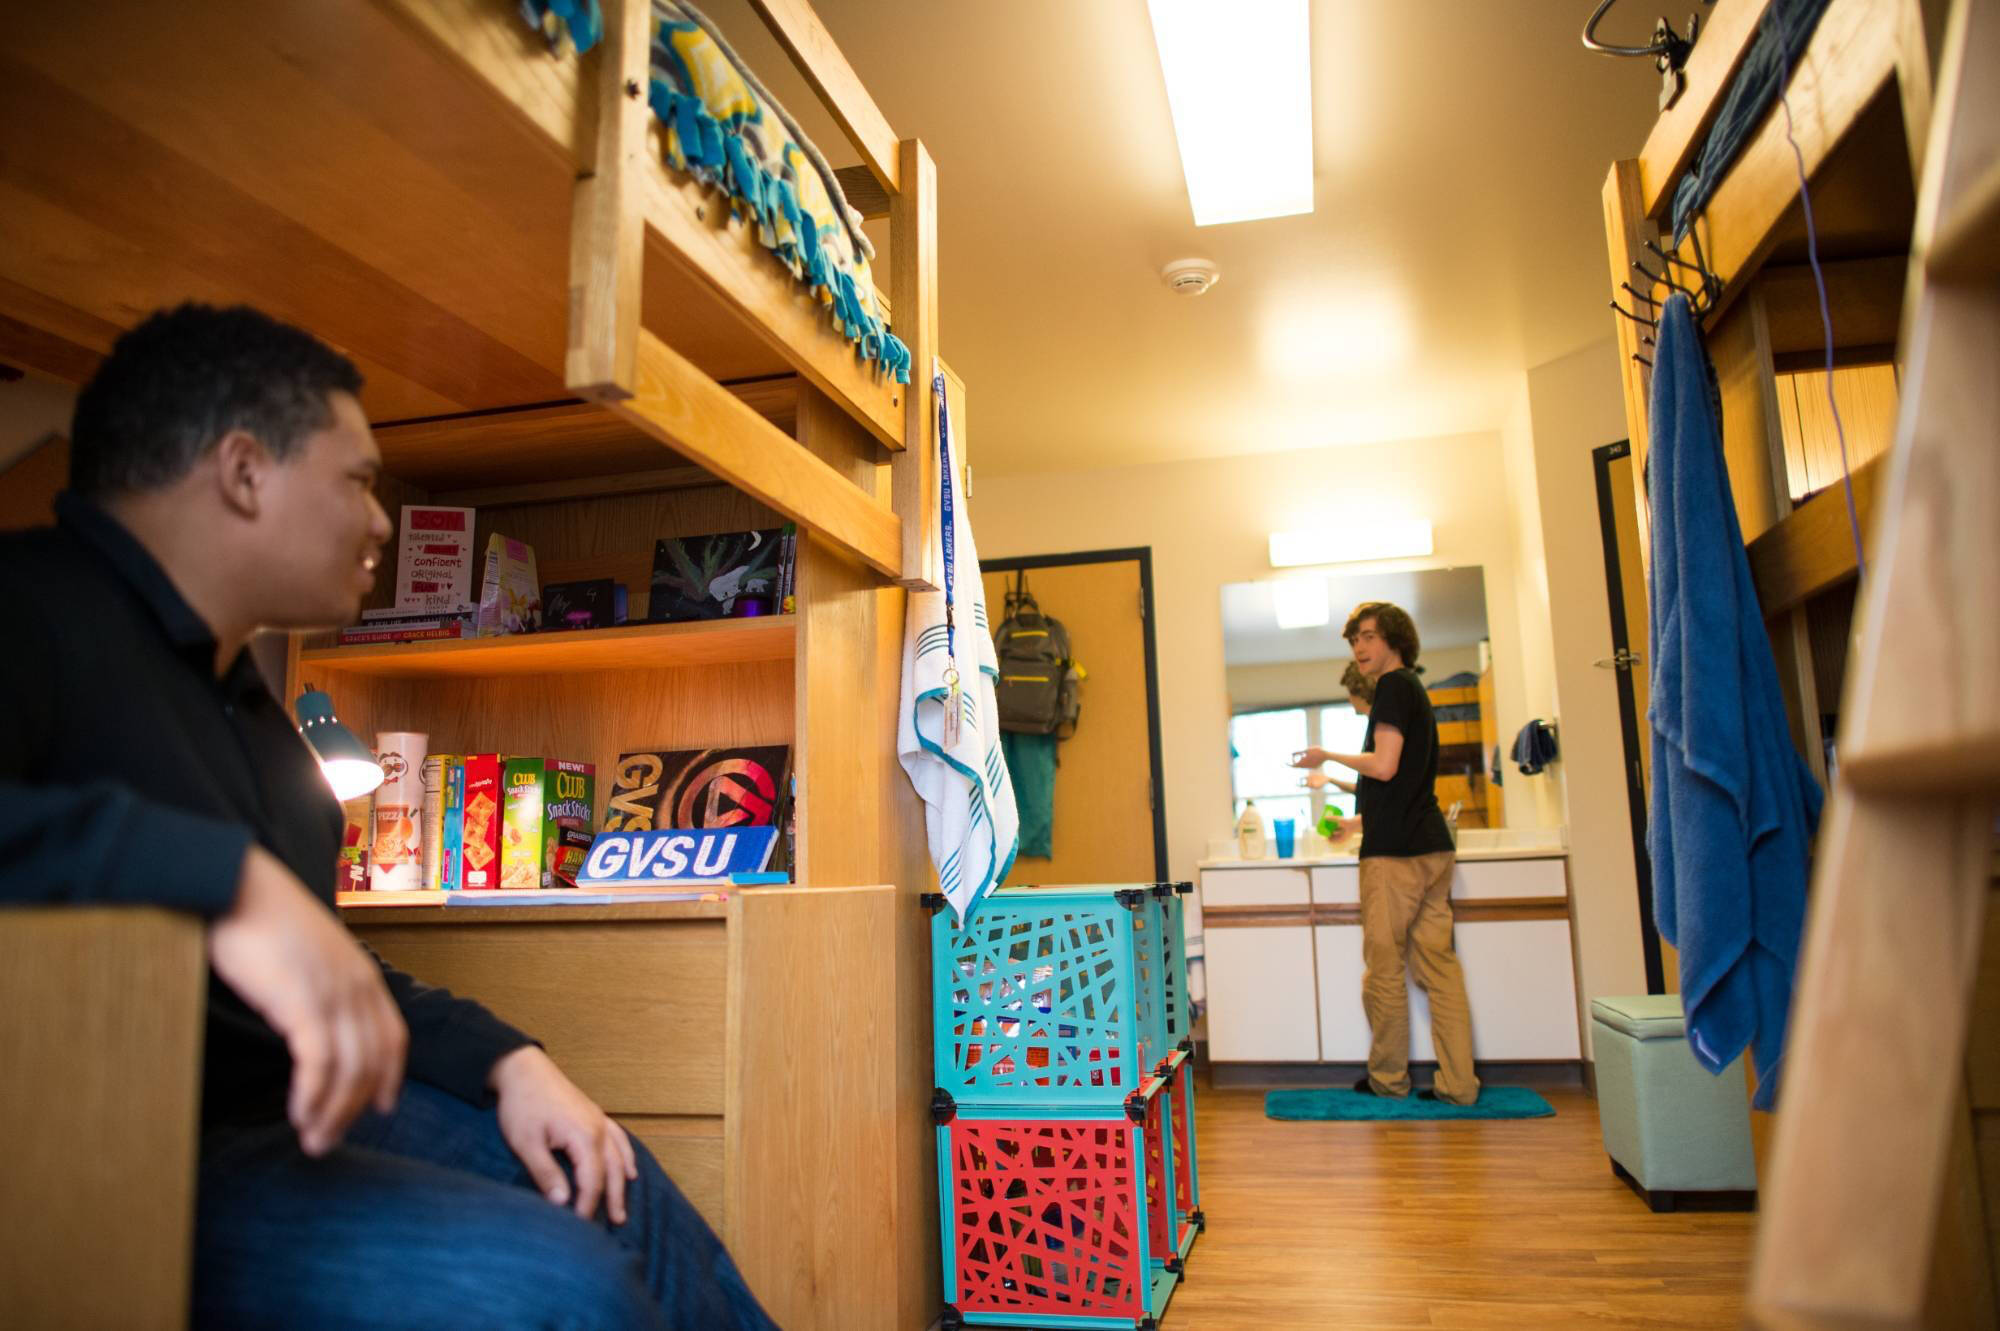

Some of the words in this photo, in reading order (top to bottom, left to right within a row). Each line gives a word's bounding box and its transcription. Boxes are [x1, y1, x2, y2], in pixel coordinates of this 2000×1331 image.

[558, 761, 585, 773] NEW!
[513, 772, 536, 785] CLUB
[557, 771, 585, 799] CLUB
[547, 799, 571, 821] Snack
[586, 833, 738, 879] GVSU
